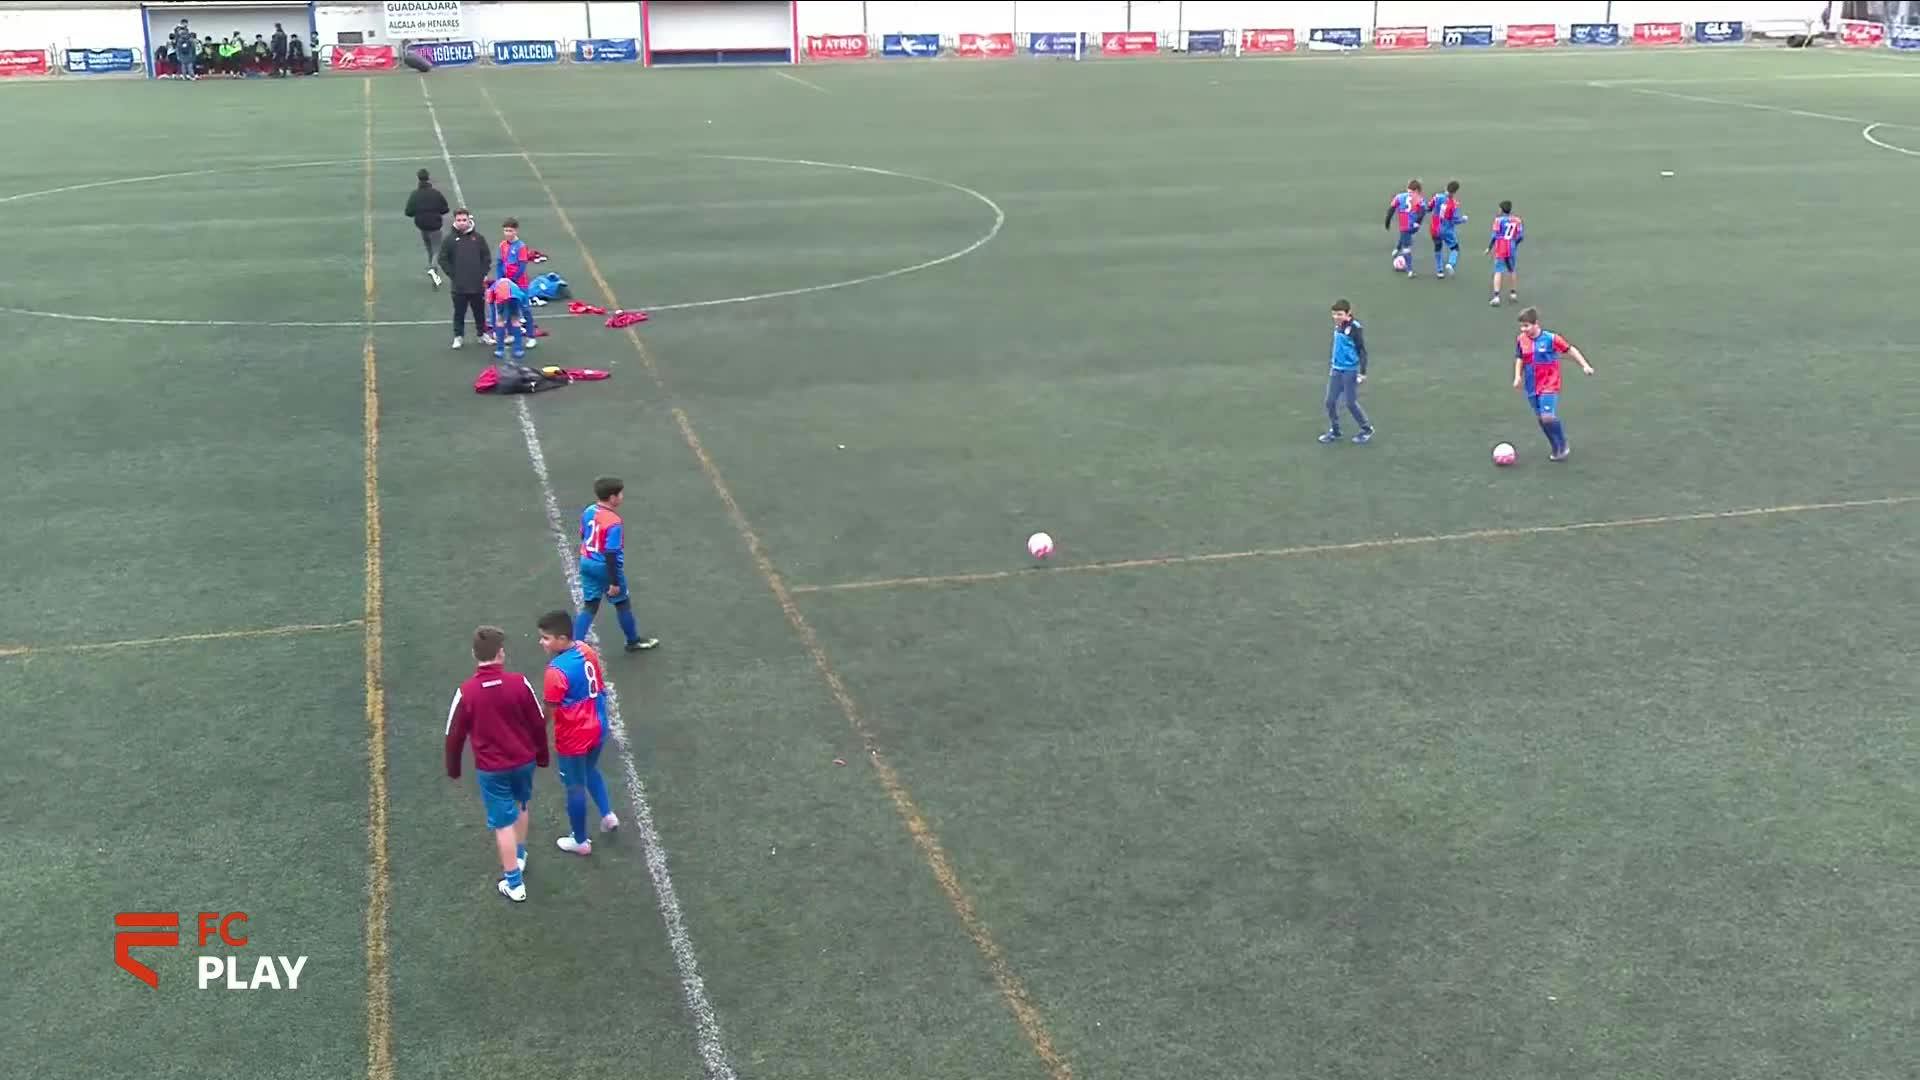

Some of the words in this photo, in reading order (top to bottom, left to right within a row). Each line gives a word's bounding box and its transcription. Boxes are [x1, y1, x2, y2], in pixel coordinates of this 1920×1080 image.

[387, 2, 458, 11] GUADALAJARA
[417, 20, 426, 28] de
[427, 19, 460, 28] HENARES
[498, 46, 510, 60] LA
[512, 44, 554, 60] SALCEDA
[826, 38, 862, 50] ATRIO
[1405, 196, 1412, 213] 5
[585, 520, 600, 553] 21
[584, 661, 598, 698] 8
